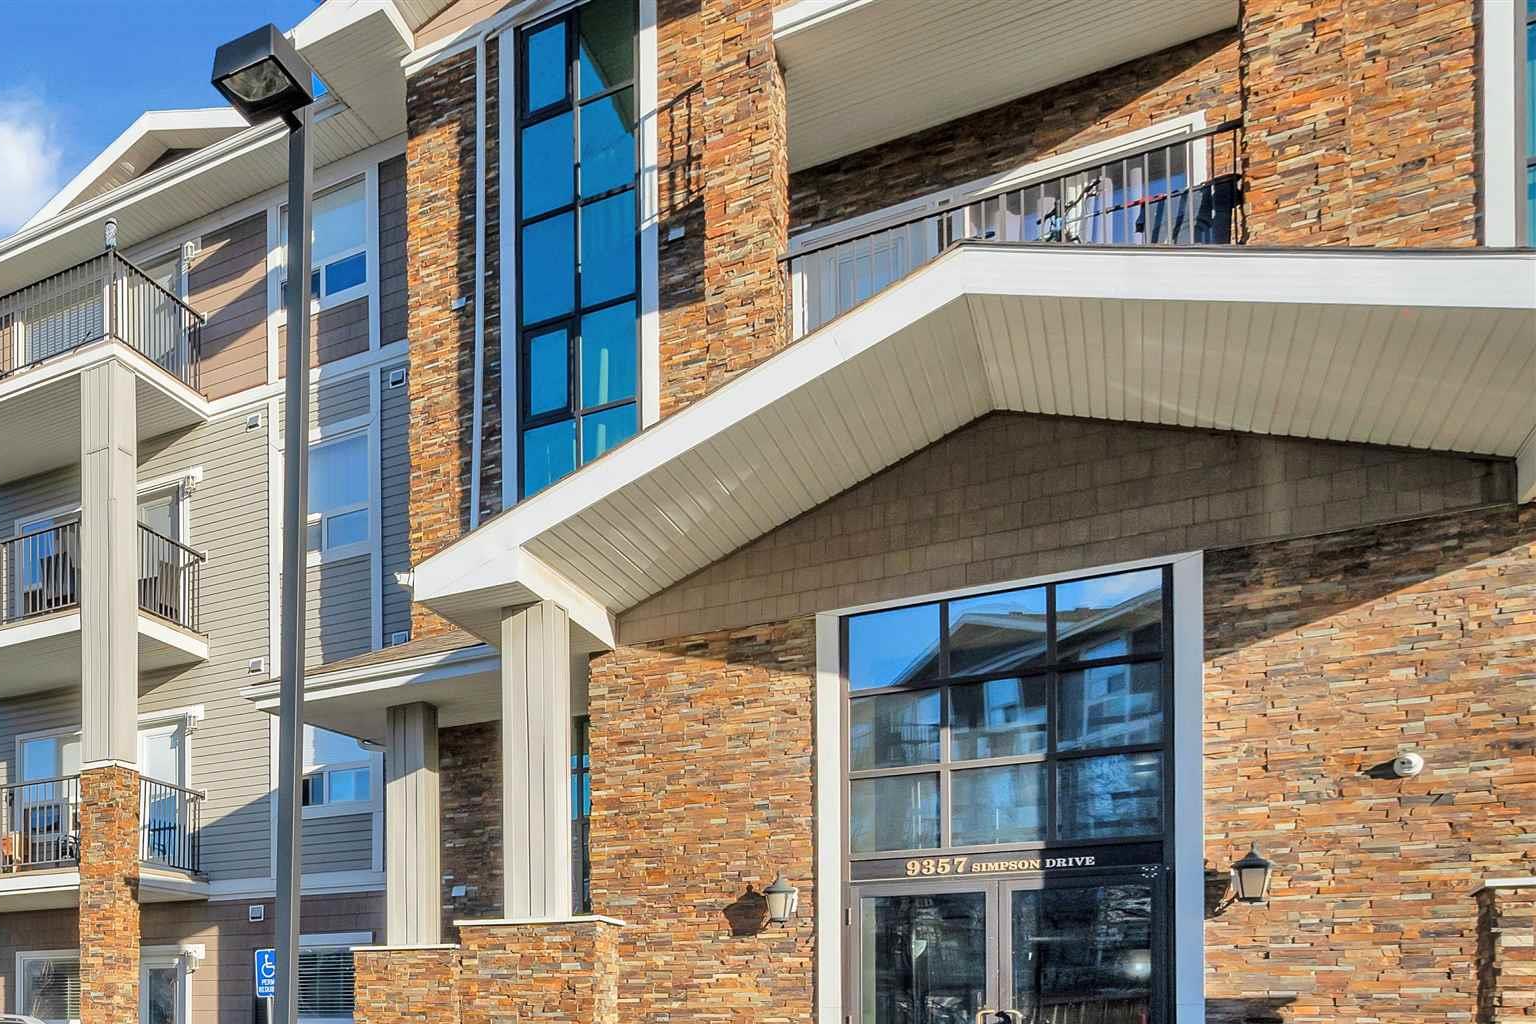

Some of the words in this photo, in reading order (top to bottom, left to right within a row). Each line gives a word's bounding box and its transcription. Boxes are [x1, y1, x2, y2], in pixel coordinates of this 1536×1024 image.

[906, 857, 968, 877] 9357
[971, 859, 1041, 873] SIMPSON
[1045, 856, 1096, 869] DRIVE
